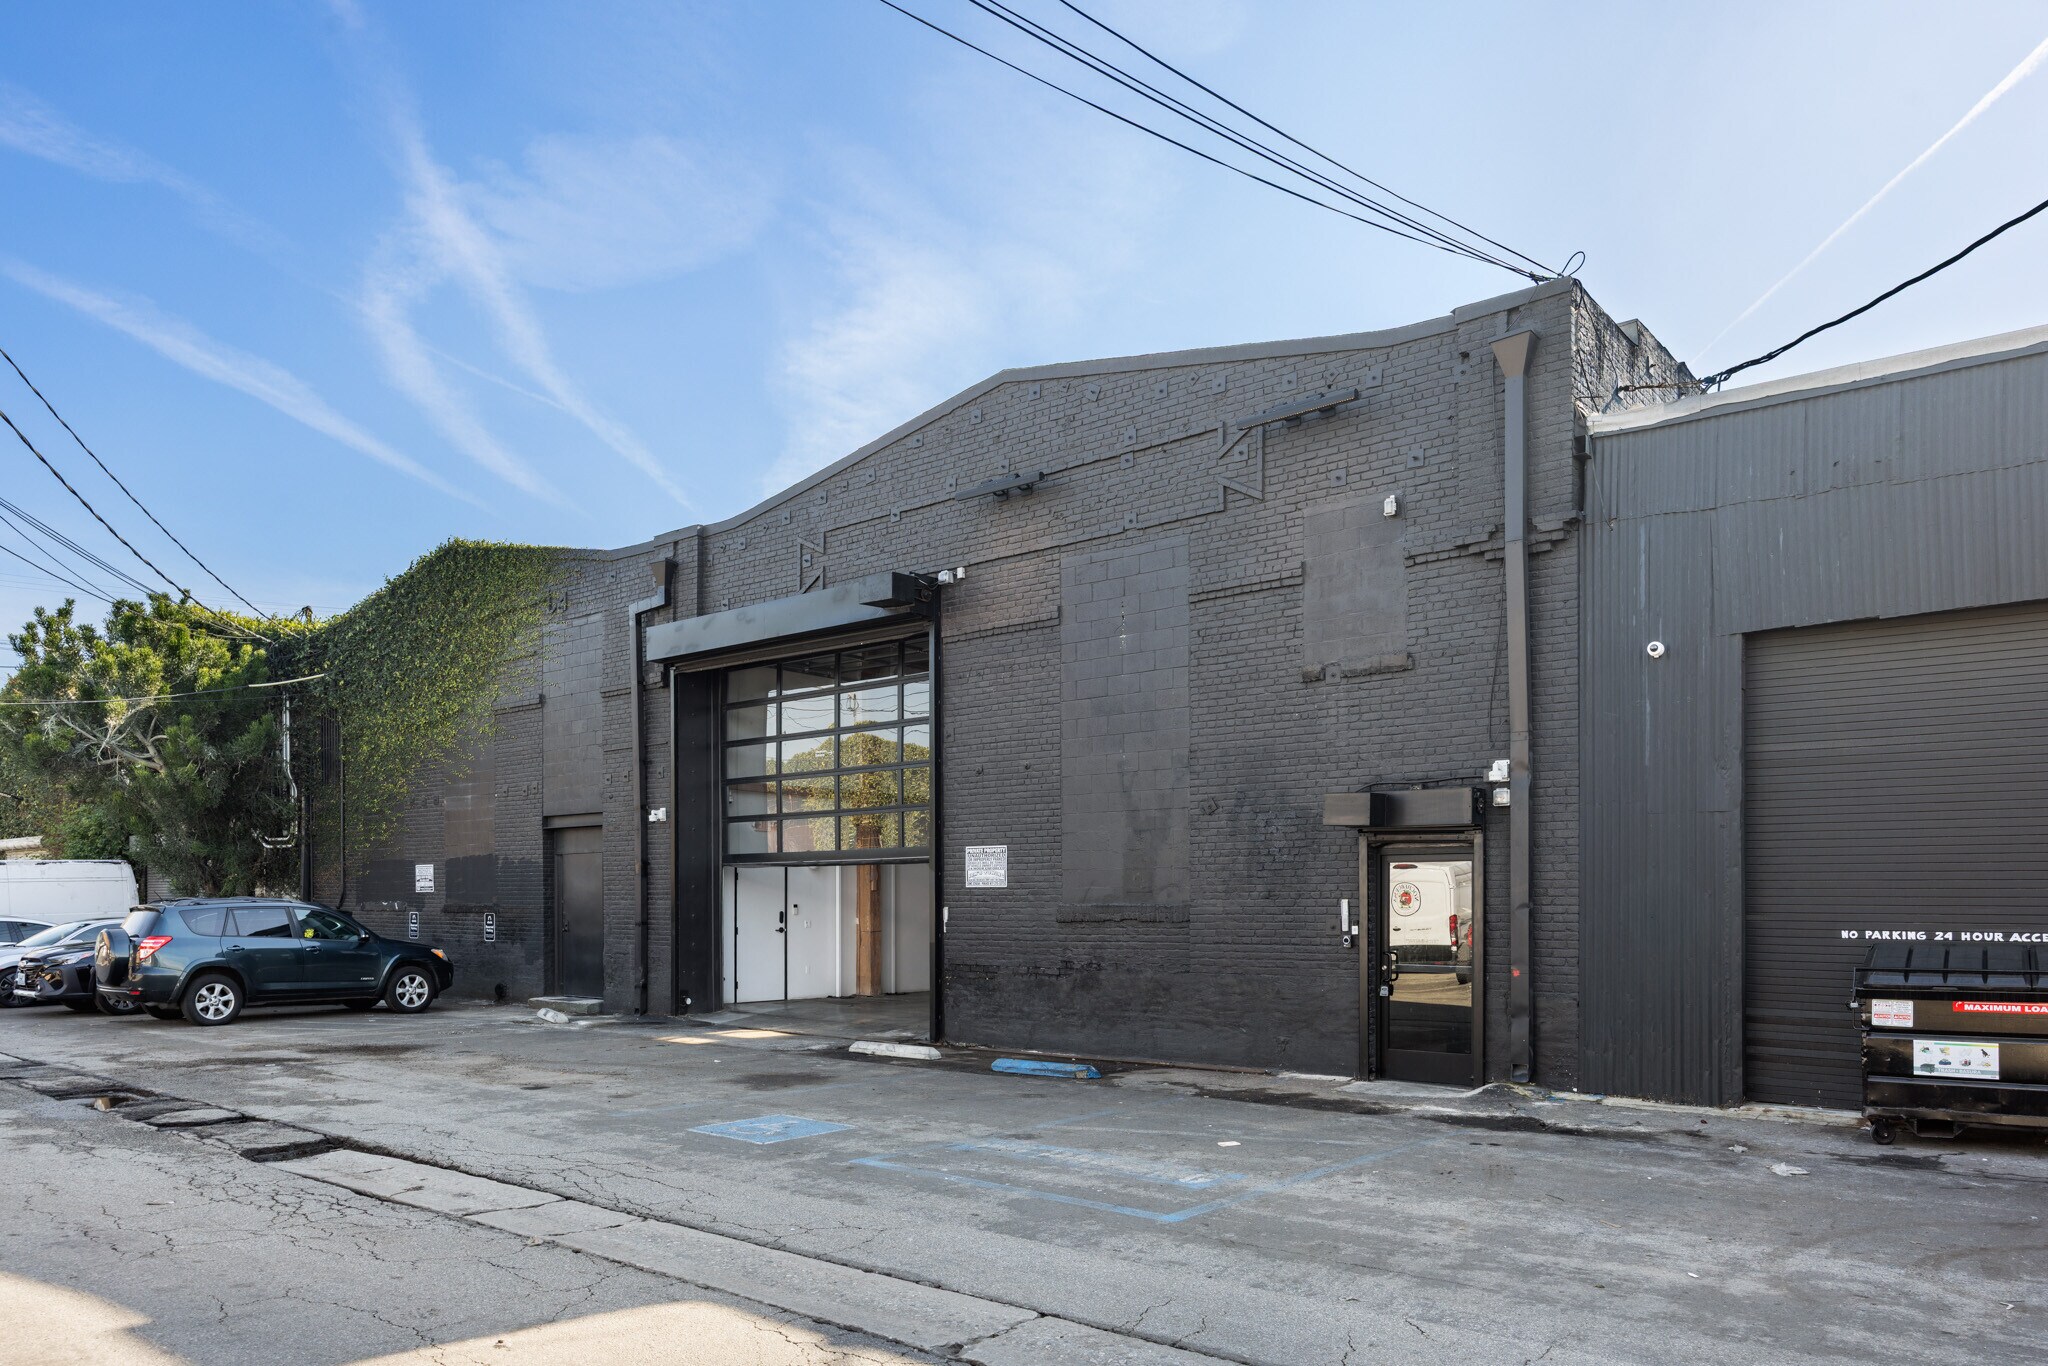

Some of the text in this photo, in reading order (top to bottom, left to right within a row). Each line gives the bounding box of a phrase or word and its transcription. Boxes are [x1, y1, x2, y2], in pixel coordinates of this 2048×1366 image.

[1841, 930, 2048, 942] NO PARKING 24 HOUR ACCE
[1964, 1004, 2048, 1013] MAXIMUM LOA
